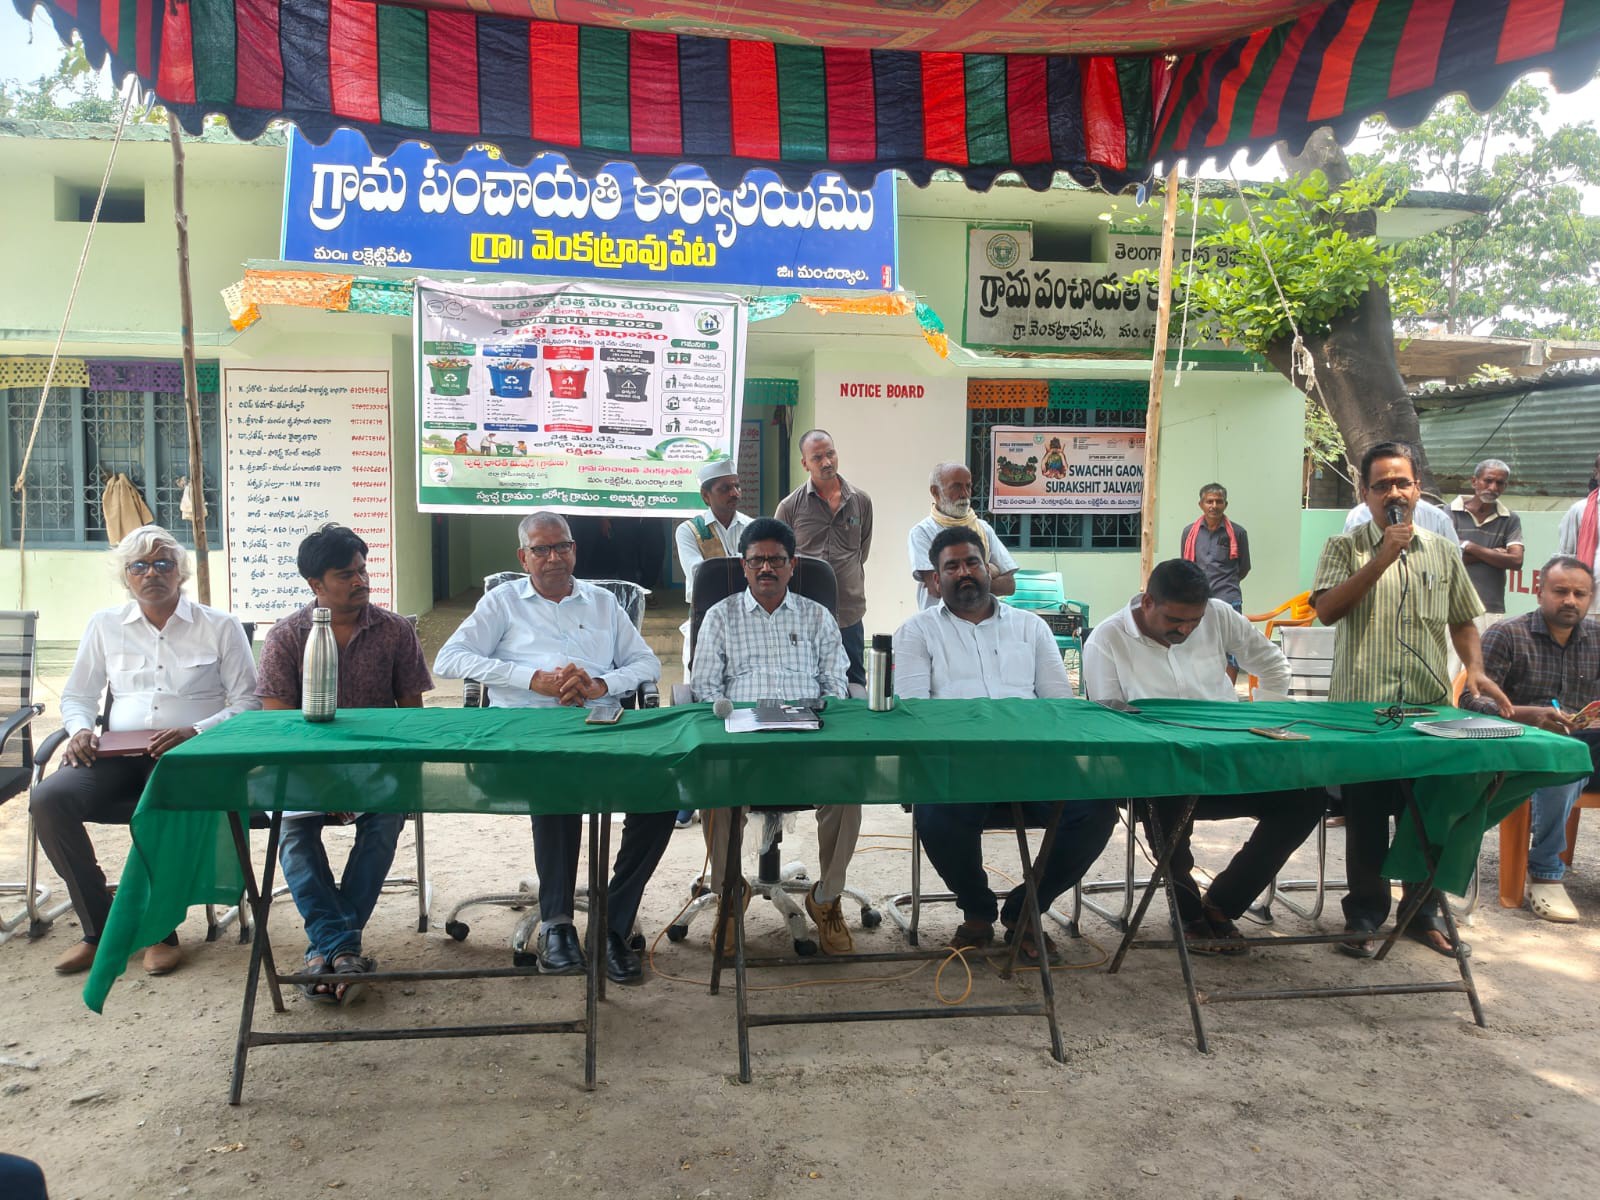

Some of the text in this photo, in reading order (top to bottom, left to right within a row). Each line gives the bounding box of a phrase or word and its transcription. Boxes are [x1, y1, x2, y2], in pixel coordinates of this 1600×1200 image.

[309, 156, 874, 248] గ్రామ పంచాయతి కార్యాలయము
[532, 229, 716, 270] వెంకట్రావుపేట
[1115, 243, 1174, 261] తెలంగా
[979, 269, 1031, 317] గ్రామ
[510, 317, 656, 329] SWM RULES 2026
[840, 383, 925, 399] NOTICE BOARD
[1069, 465, 1113, 477] SWACHH
[1046, 481, 1143, 493] SURAKSHIT JALVAYU
